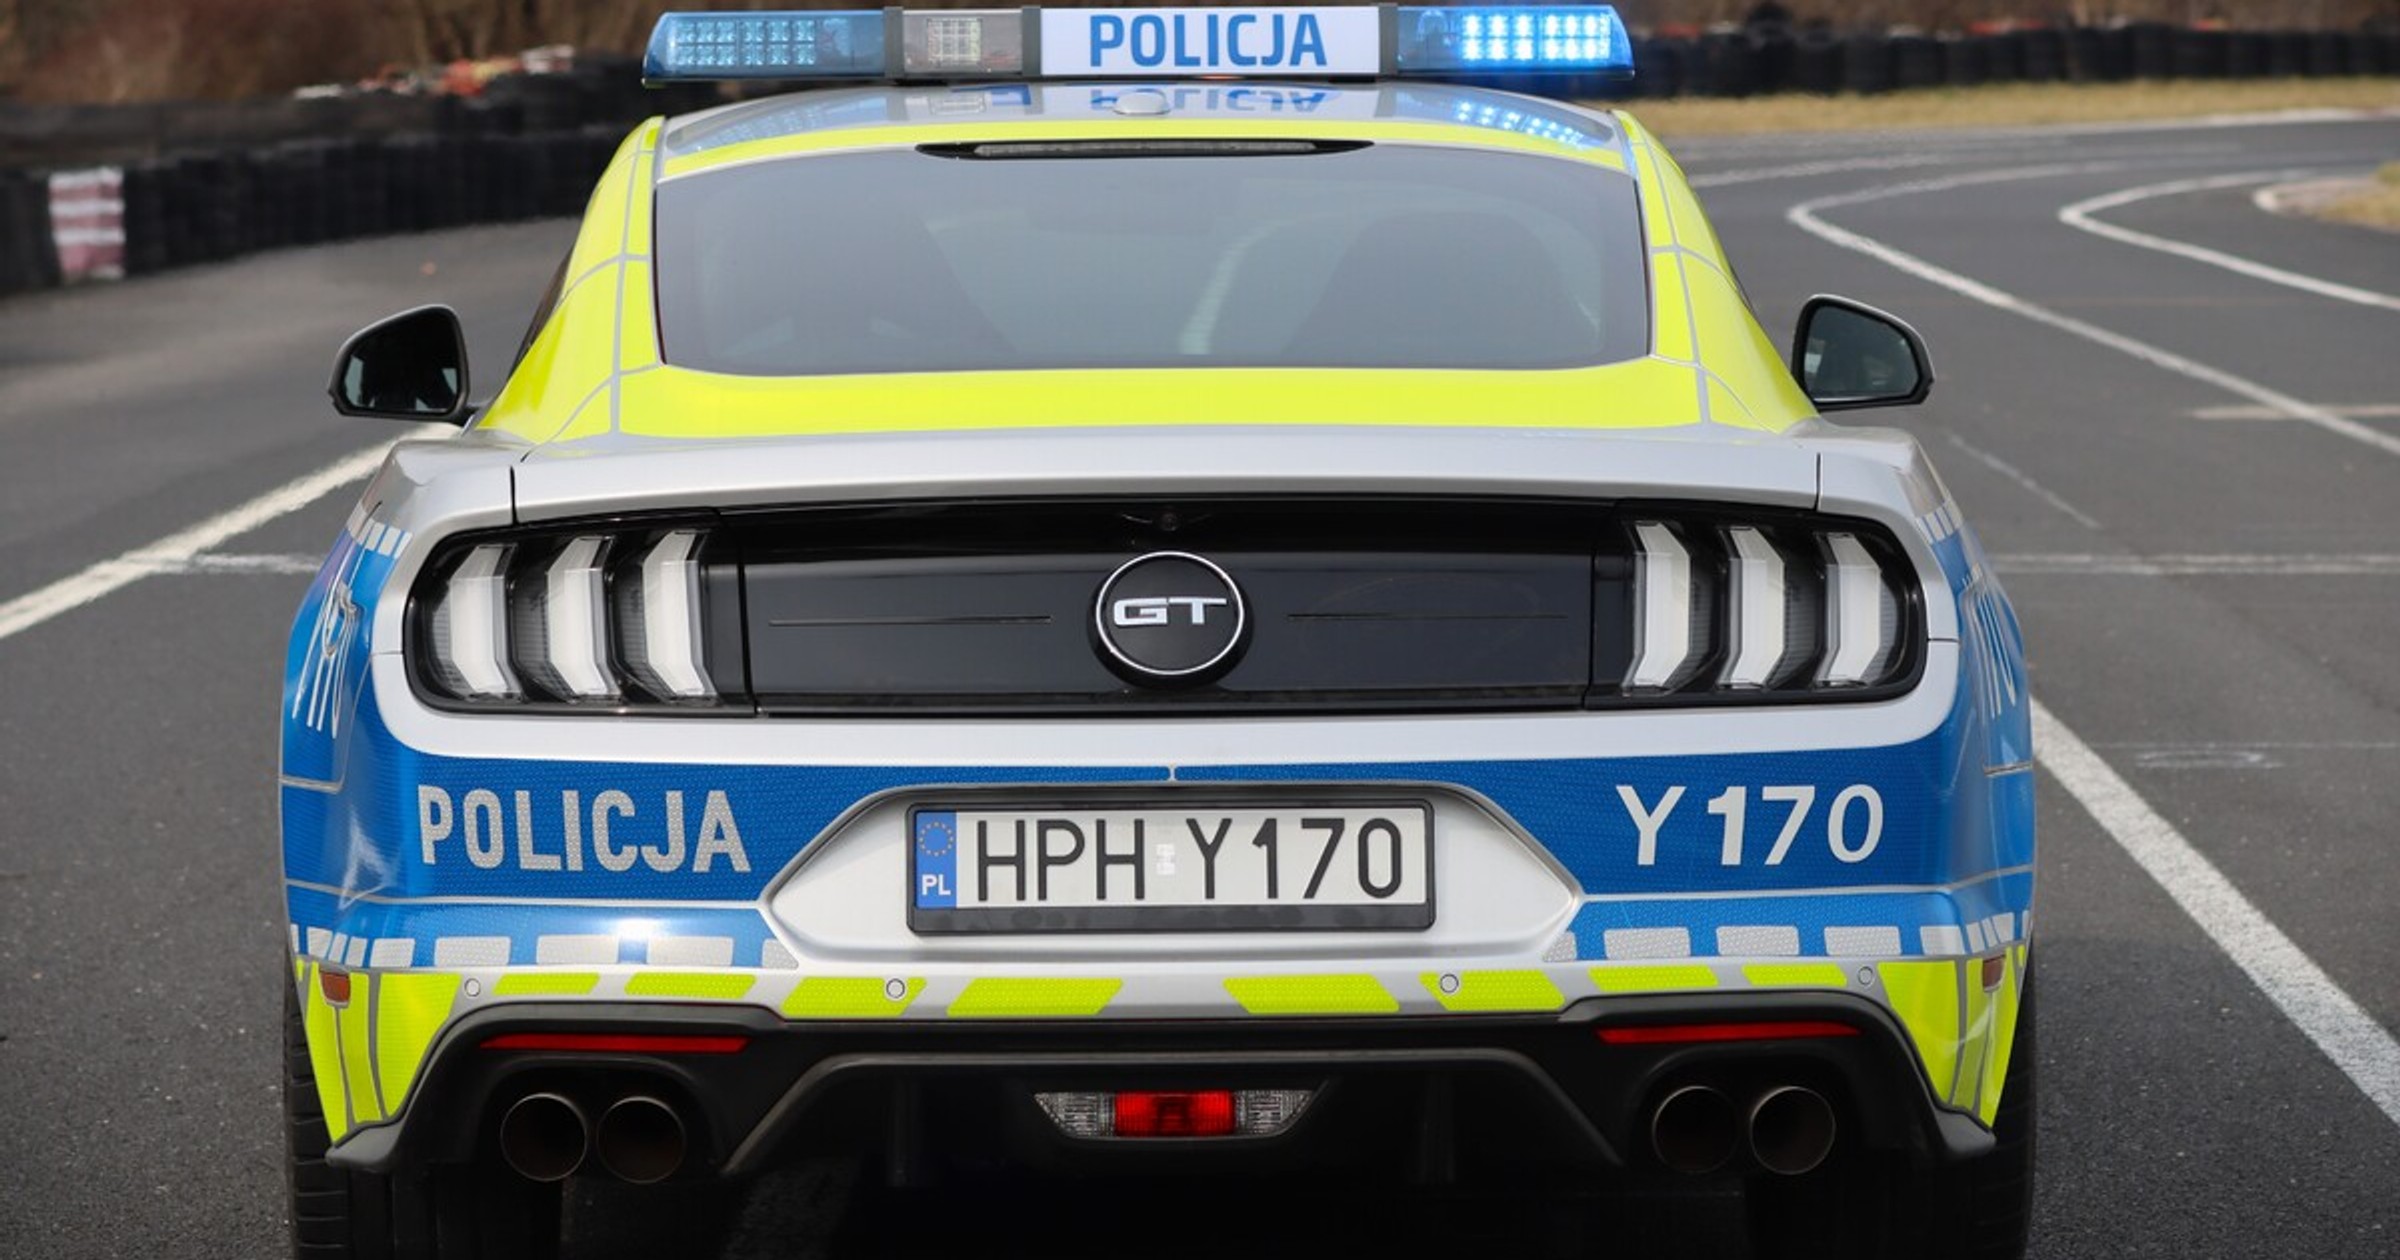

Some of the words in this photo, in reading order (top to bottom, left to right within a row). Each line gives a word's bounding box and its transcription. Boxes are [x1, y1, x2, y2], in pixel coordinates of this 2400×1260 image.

[1088, 12, 1328, 69] POLICJA
[1113, 597, 1227, 626] GT
[418, 785, 751, 873] POLICJA
[922, 873, 951, 896] PL
[977, 818, 1145, 902] HPH
[1186, 818, 1402, 901] Y170
